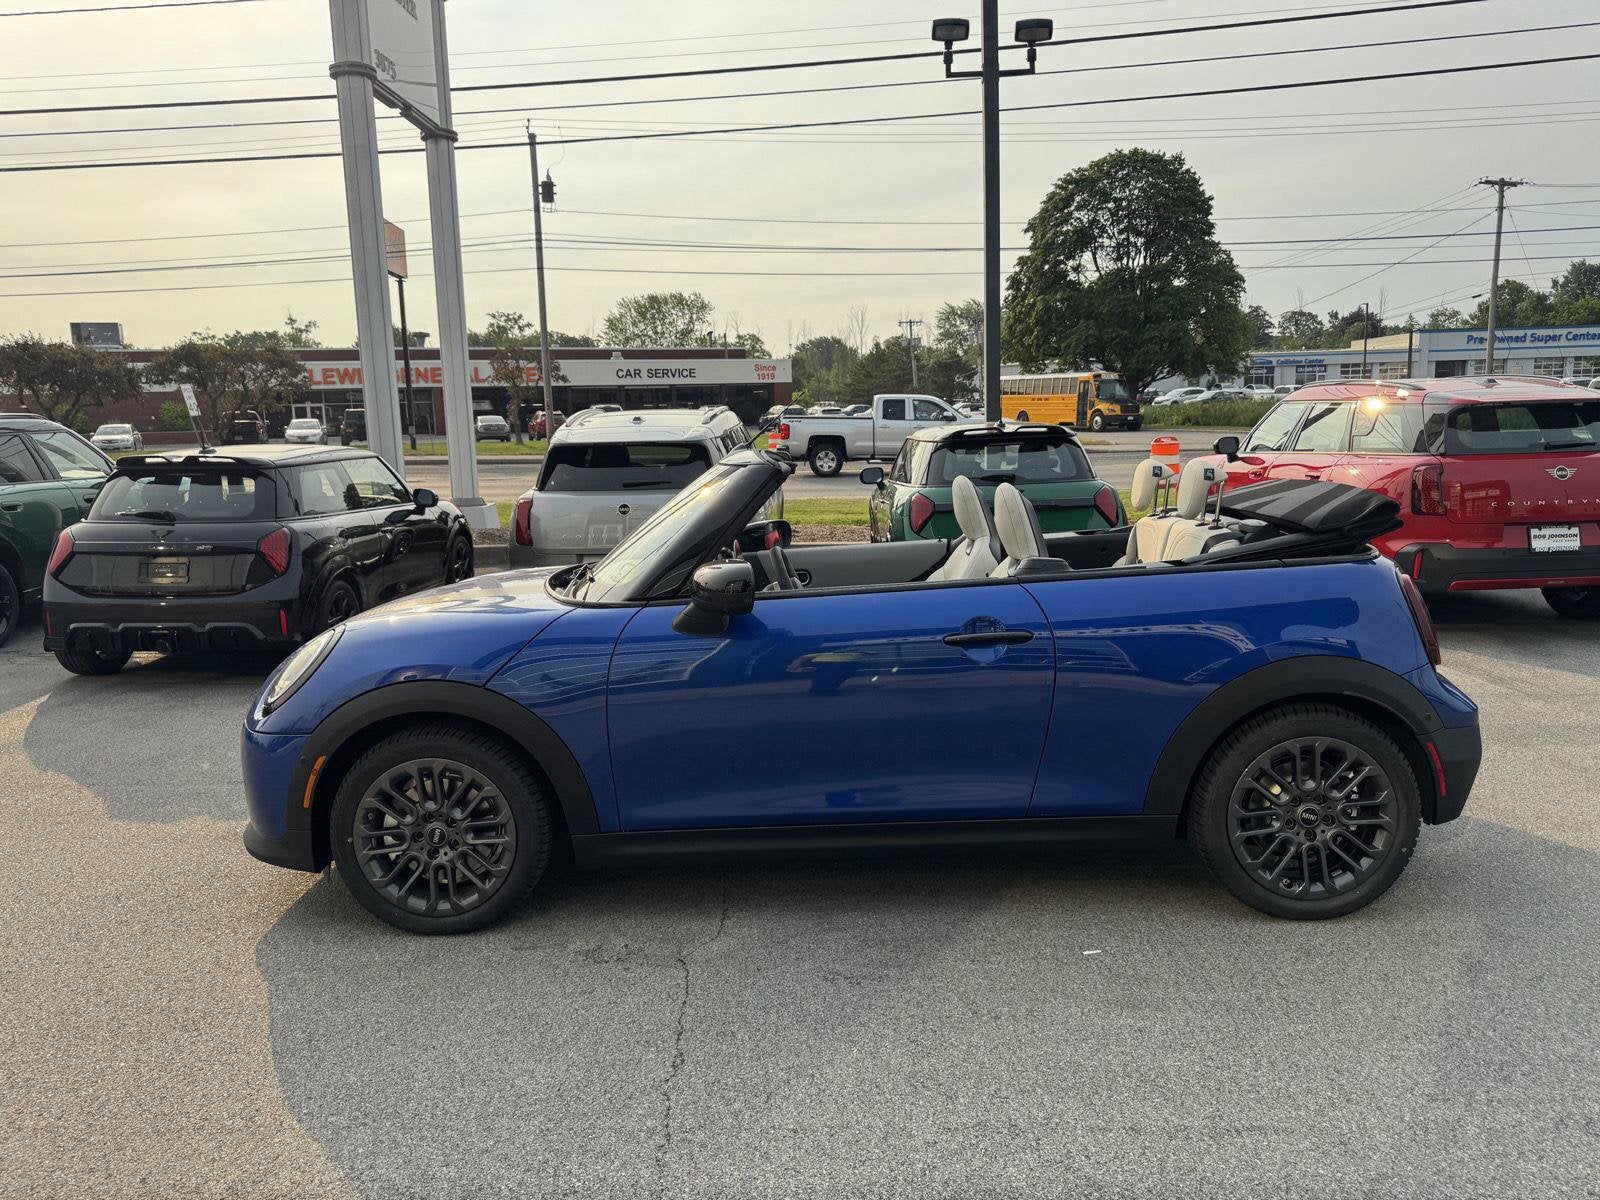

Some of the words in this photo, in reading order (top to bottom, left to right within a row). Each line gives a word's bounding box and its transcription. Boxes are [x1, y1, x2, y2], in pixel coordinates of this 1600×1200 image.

[1529, 333, 1563, 344] Super
[754, 363, 777, 372] Since
[308, 367, 363, 385] LEWI
[616, 368, 642, 379] CAR
[646, 368, 697, 379] SERVICE
[756, 372, 776, 381] 1919
[1302, 813, 1317, 821] MINI
